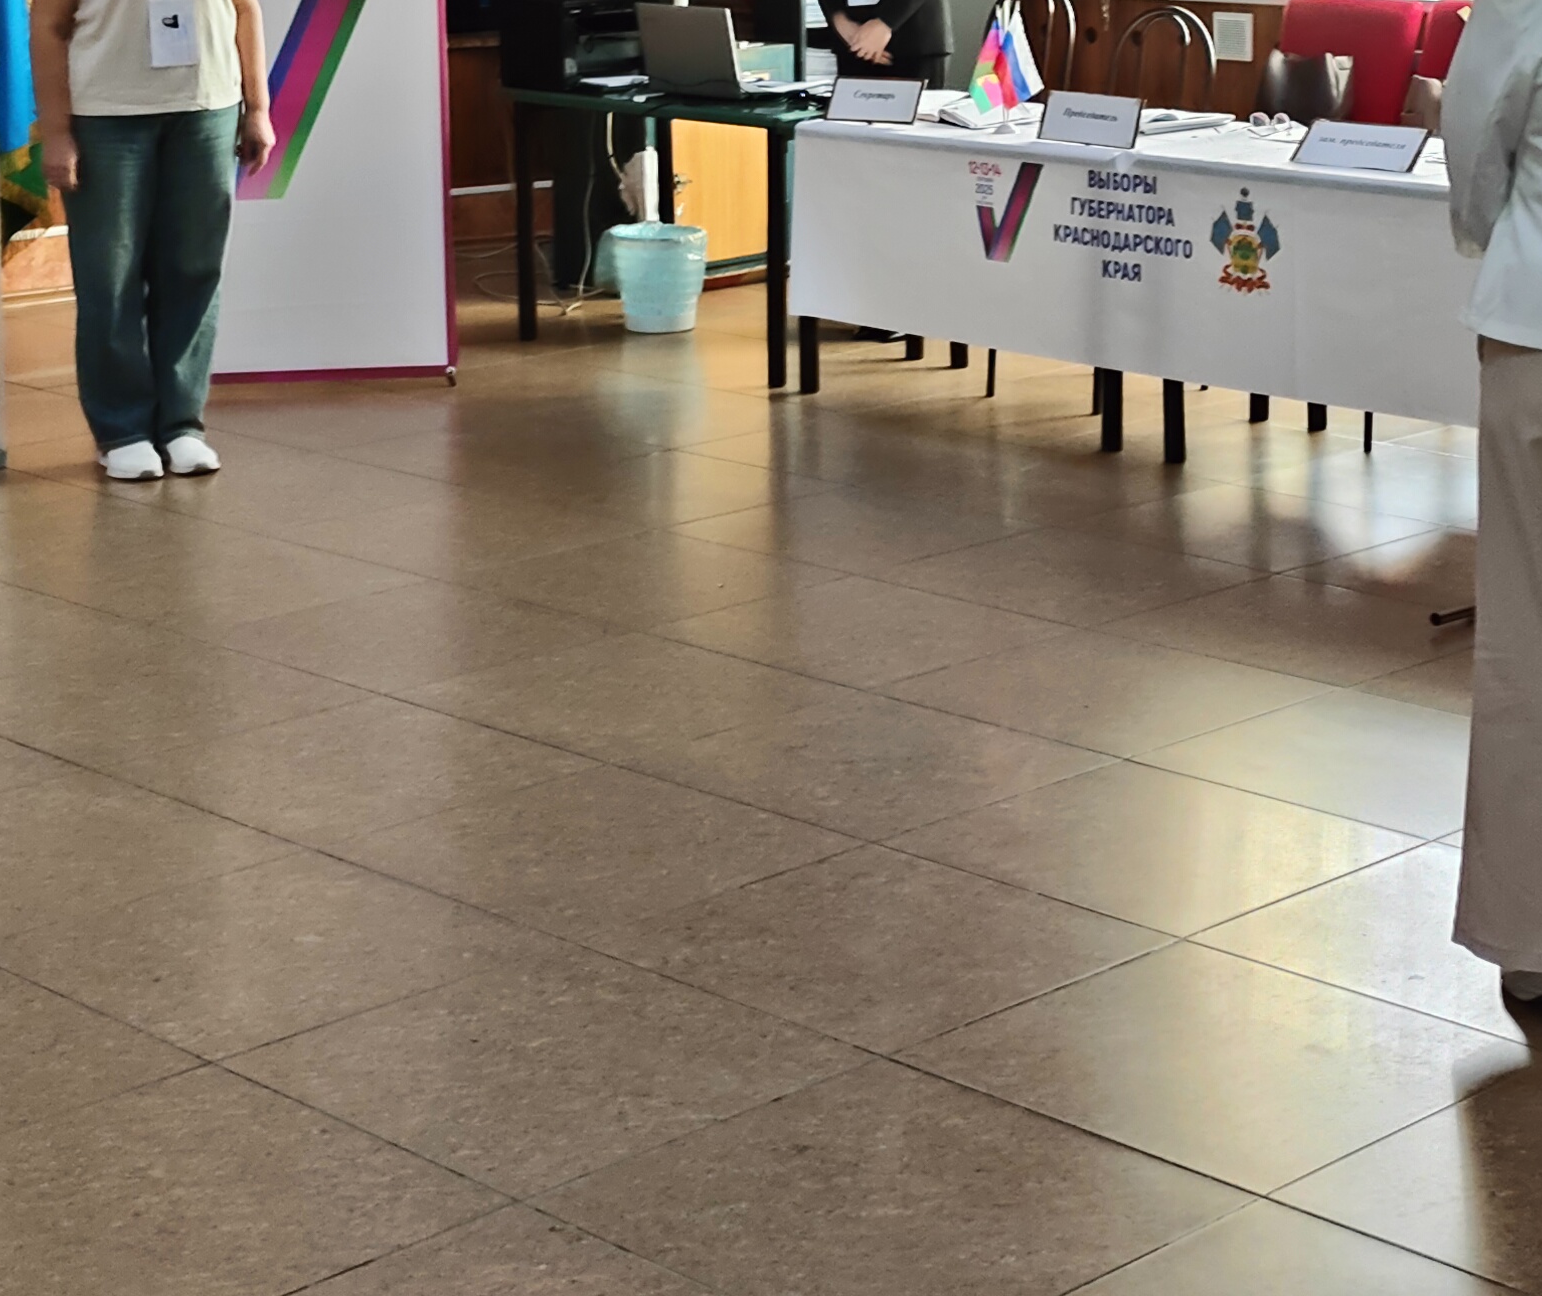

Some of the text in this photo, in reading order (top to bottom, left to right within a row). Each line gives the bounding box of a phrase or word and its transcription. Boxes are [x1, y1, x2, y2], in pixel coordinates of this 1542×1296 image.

[1087, 169, 1158, 194] ВЫБОРЫ
[1070, 196, 1176, 227] ГУБЕРНАТОРА
[1053, 224, 1193, 259] КРАСНОДАРСКОГО
[1101, 259, 1142, 282] КРАЯ
